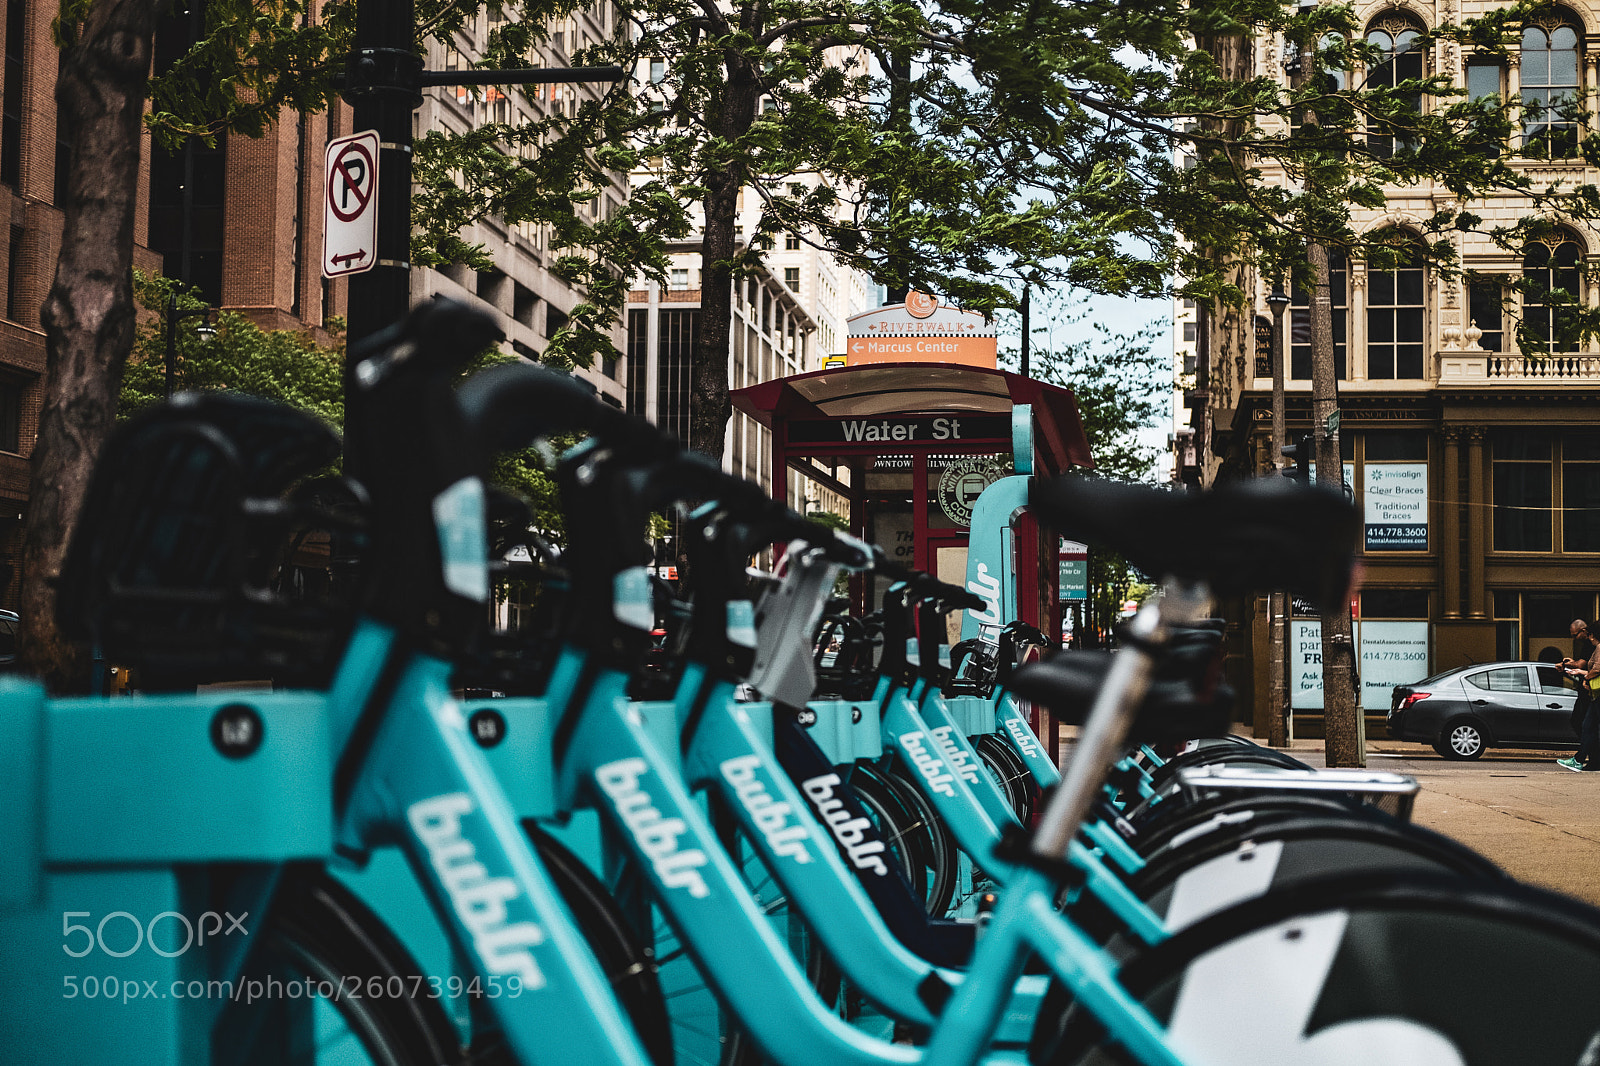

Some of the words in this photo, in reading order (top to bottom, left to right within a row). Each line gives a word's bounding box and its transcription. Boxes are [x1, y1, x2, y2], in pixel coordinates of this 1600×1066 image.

[879, 321, 965, 333] RIVERWALK
[868, 342, 912, 353] Marcus
[916, 341, 959, 353] Center
[1352, 410, 1417, 419] ASSOCIATES
[841, 420, 917, 442] Water
[932, 418, 960, 440] St
[1385, 471, 1422, 480] invisalign
[1369, 486, 1392, 495] Clear
[1395, 486, 1424, 495] Braces
[1375, 502, 1420, 510] Traditional
[1383, 511, 1412, 520] Braces
[1367, 527, 1427, 537] 414.778.3600
[1300, 626, 1320, 638] Pat
[1303, 653, 1322, 664] FR
[1362, 651, 1426, 661] 414.778.3600
[1302, 672, 1319, 680] Ask
[1301, 681, 1314, 690] for
[1005, 718, 1038, 759] bublr
[932, 725, 980, 784] bublr
[899, 731, 956, 797] bublr
[719, 754, 810, 865] bublr
[594, 757, 711, 898] bublr
[801, 773, 888, 876] bublr
[407, 791, 547, 990] bublr
